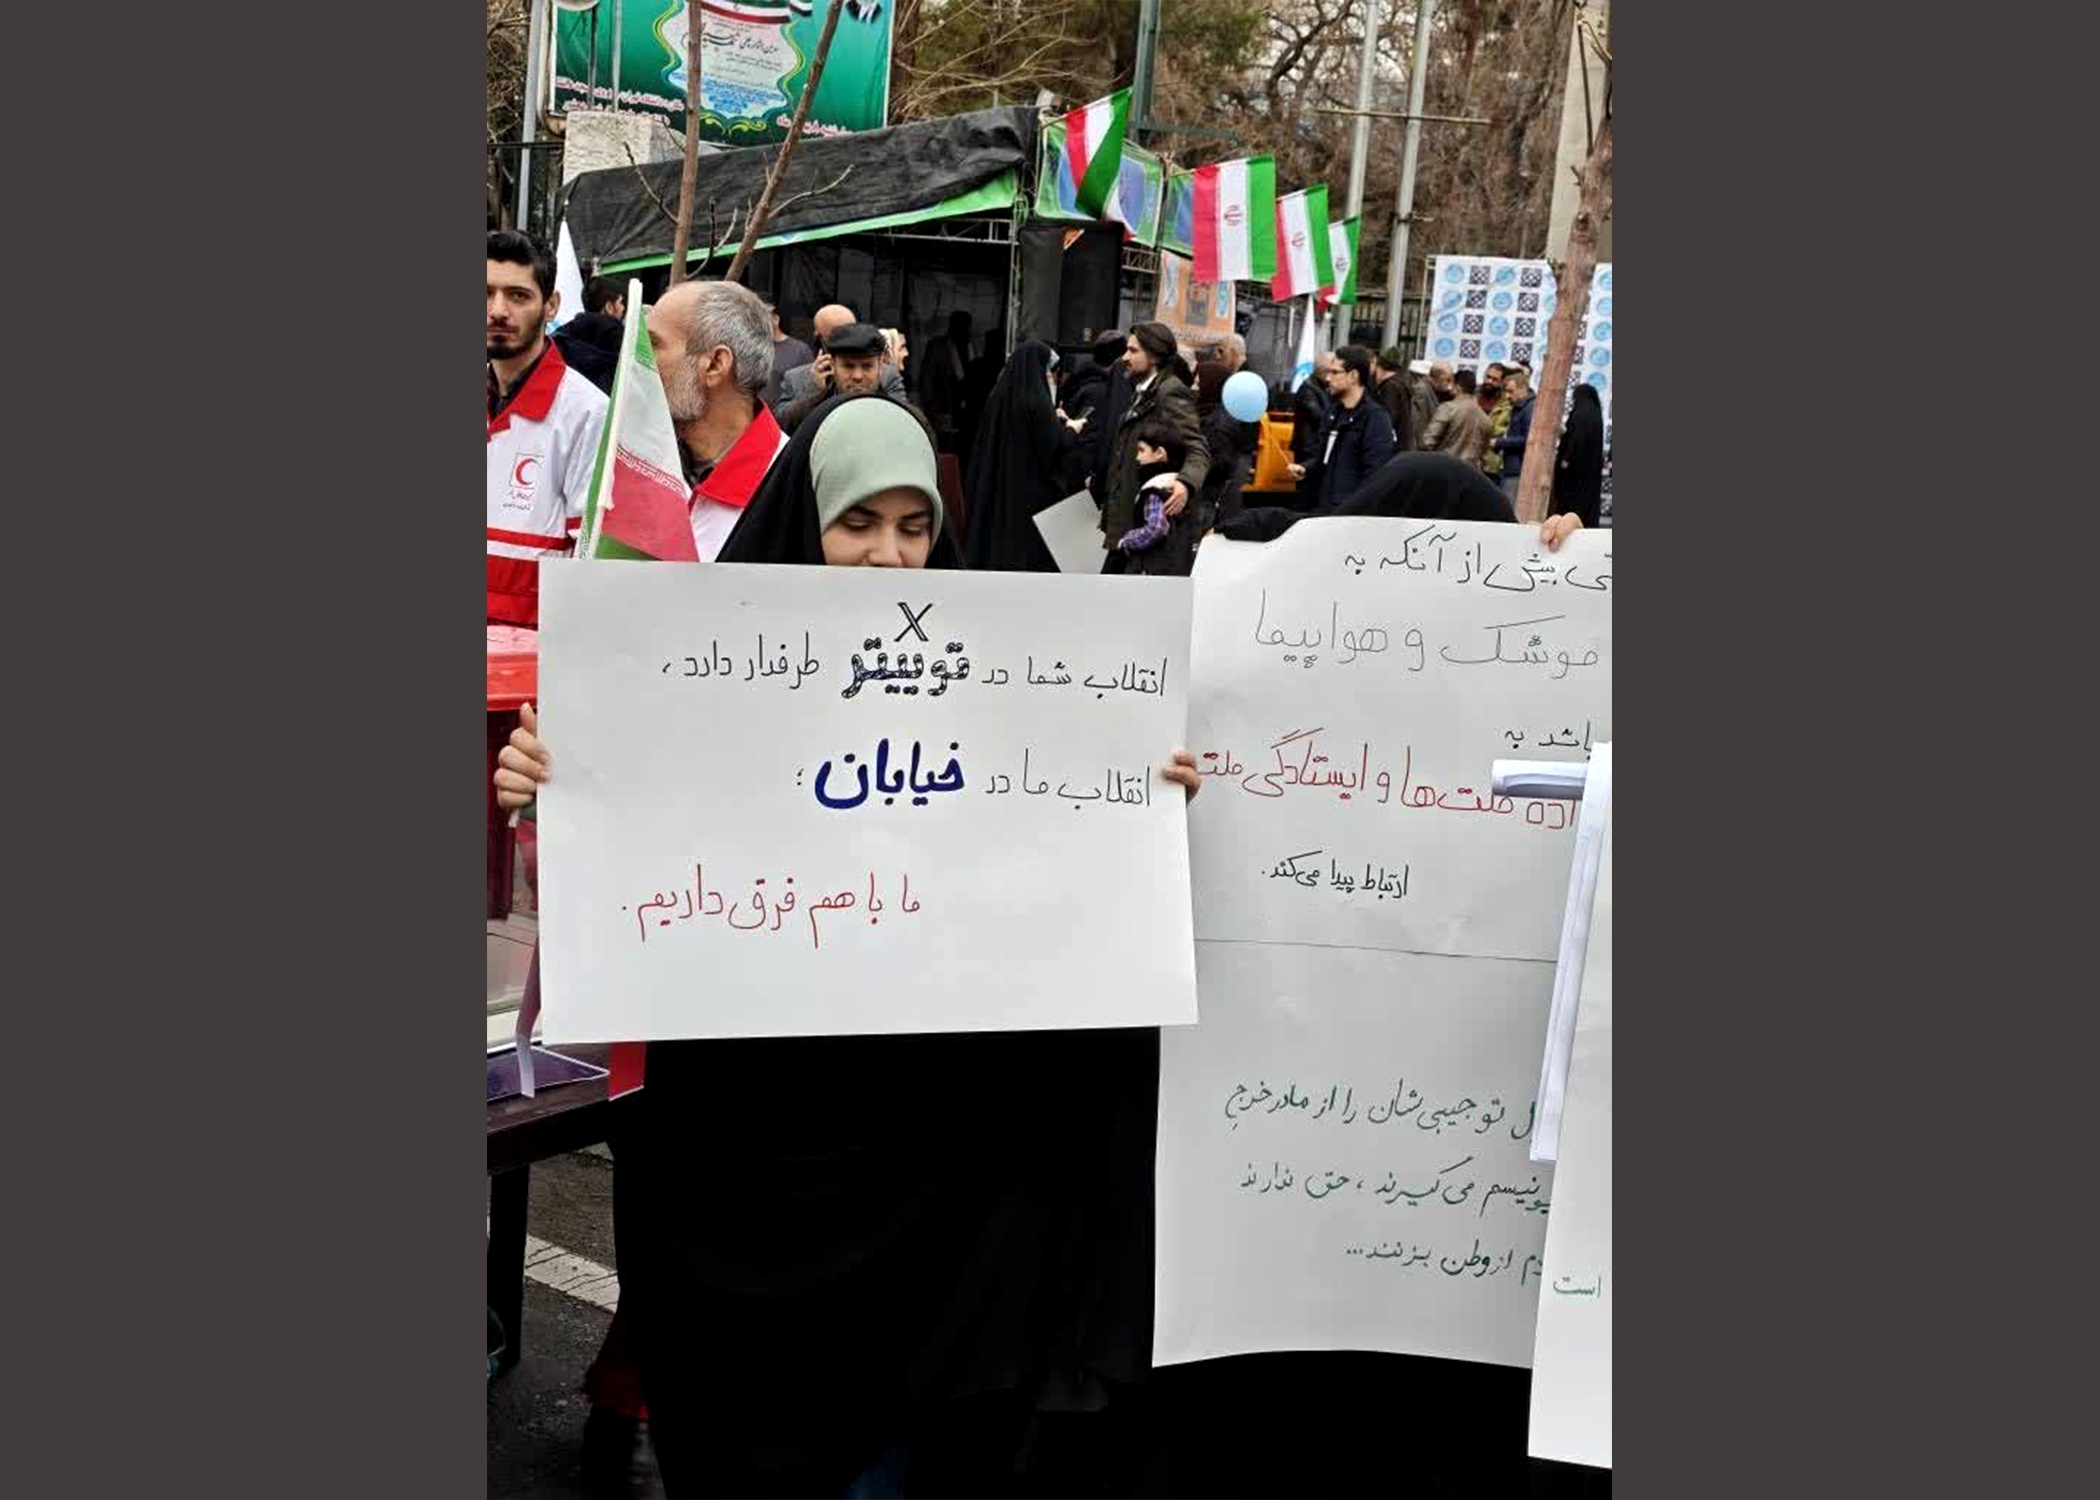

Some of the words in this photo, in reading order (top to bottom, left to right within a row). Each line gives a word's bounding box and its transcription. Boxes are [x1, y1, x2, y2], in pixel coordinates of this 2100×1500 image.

[1344, 553, 1366, 575] به
[1379, 524, 1458, 573] آنکه
[1456, 541, 1481, 585] از
[1483, 552, 1557, 592] بیش
[893, 601, 934, 642] X
[1254, 586, 1389, 669] هواپیما
[743, 630, 820, 691] طرفدار
[1403, 628, 1426, 672] و
[1438, 614, 1599, 680] موشک
[981, 665, 1010, 686] در
[1026, 655, 1073, 686] شما
[1083, 656, 1168, 699] انقلاب
[1504, 729, 1526, 751] به
[1022, 747, 1050, 796] ما
[1196, 749, 1244, 776] ملت
[1241, 726, 1369, 798] ایستادگی
[984, 774, 1011, 795] در
[1056, 764, 1152, 811] انقلاب
[1375, 770, 1391, 804] و
[1526, 797, 1577, 830] اده
[901, 873, 921, 914] ما
[1330, 857, 1355, 895] پیدا
[1360, 862, 1410, 900] ارتباط
[728, 876, 795, 932] فرق
[867, 870, 884, 926] با
[808, 891, 856, 950] هم
[1312, 1084, 1338, 1120] از
[1342, 1087, 1358, 1125] را
[1240, 1161, 1294, 1193] ندارند
[1304, 1170, 1351, 1200] حق
[1439, 1238, 1492, 1279] وطن
[1488, 1248, 1514, 1276] از
[1552, 1276, 1602, 1299] است
